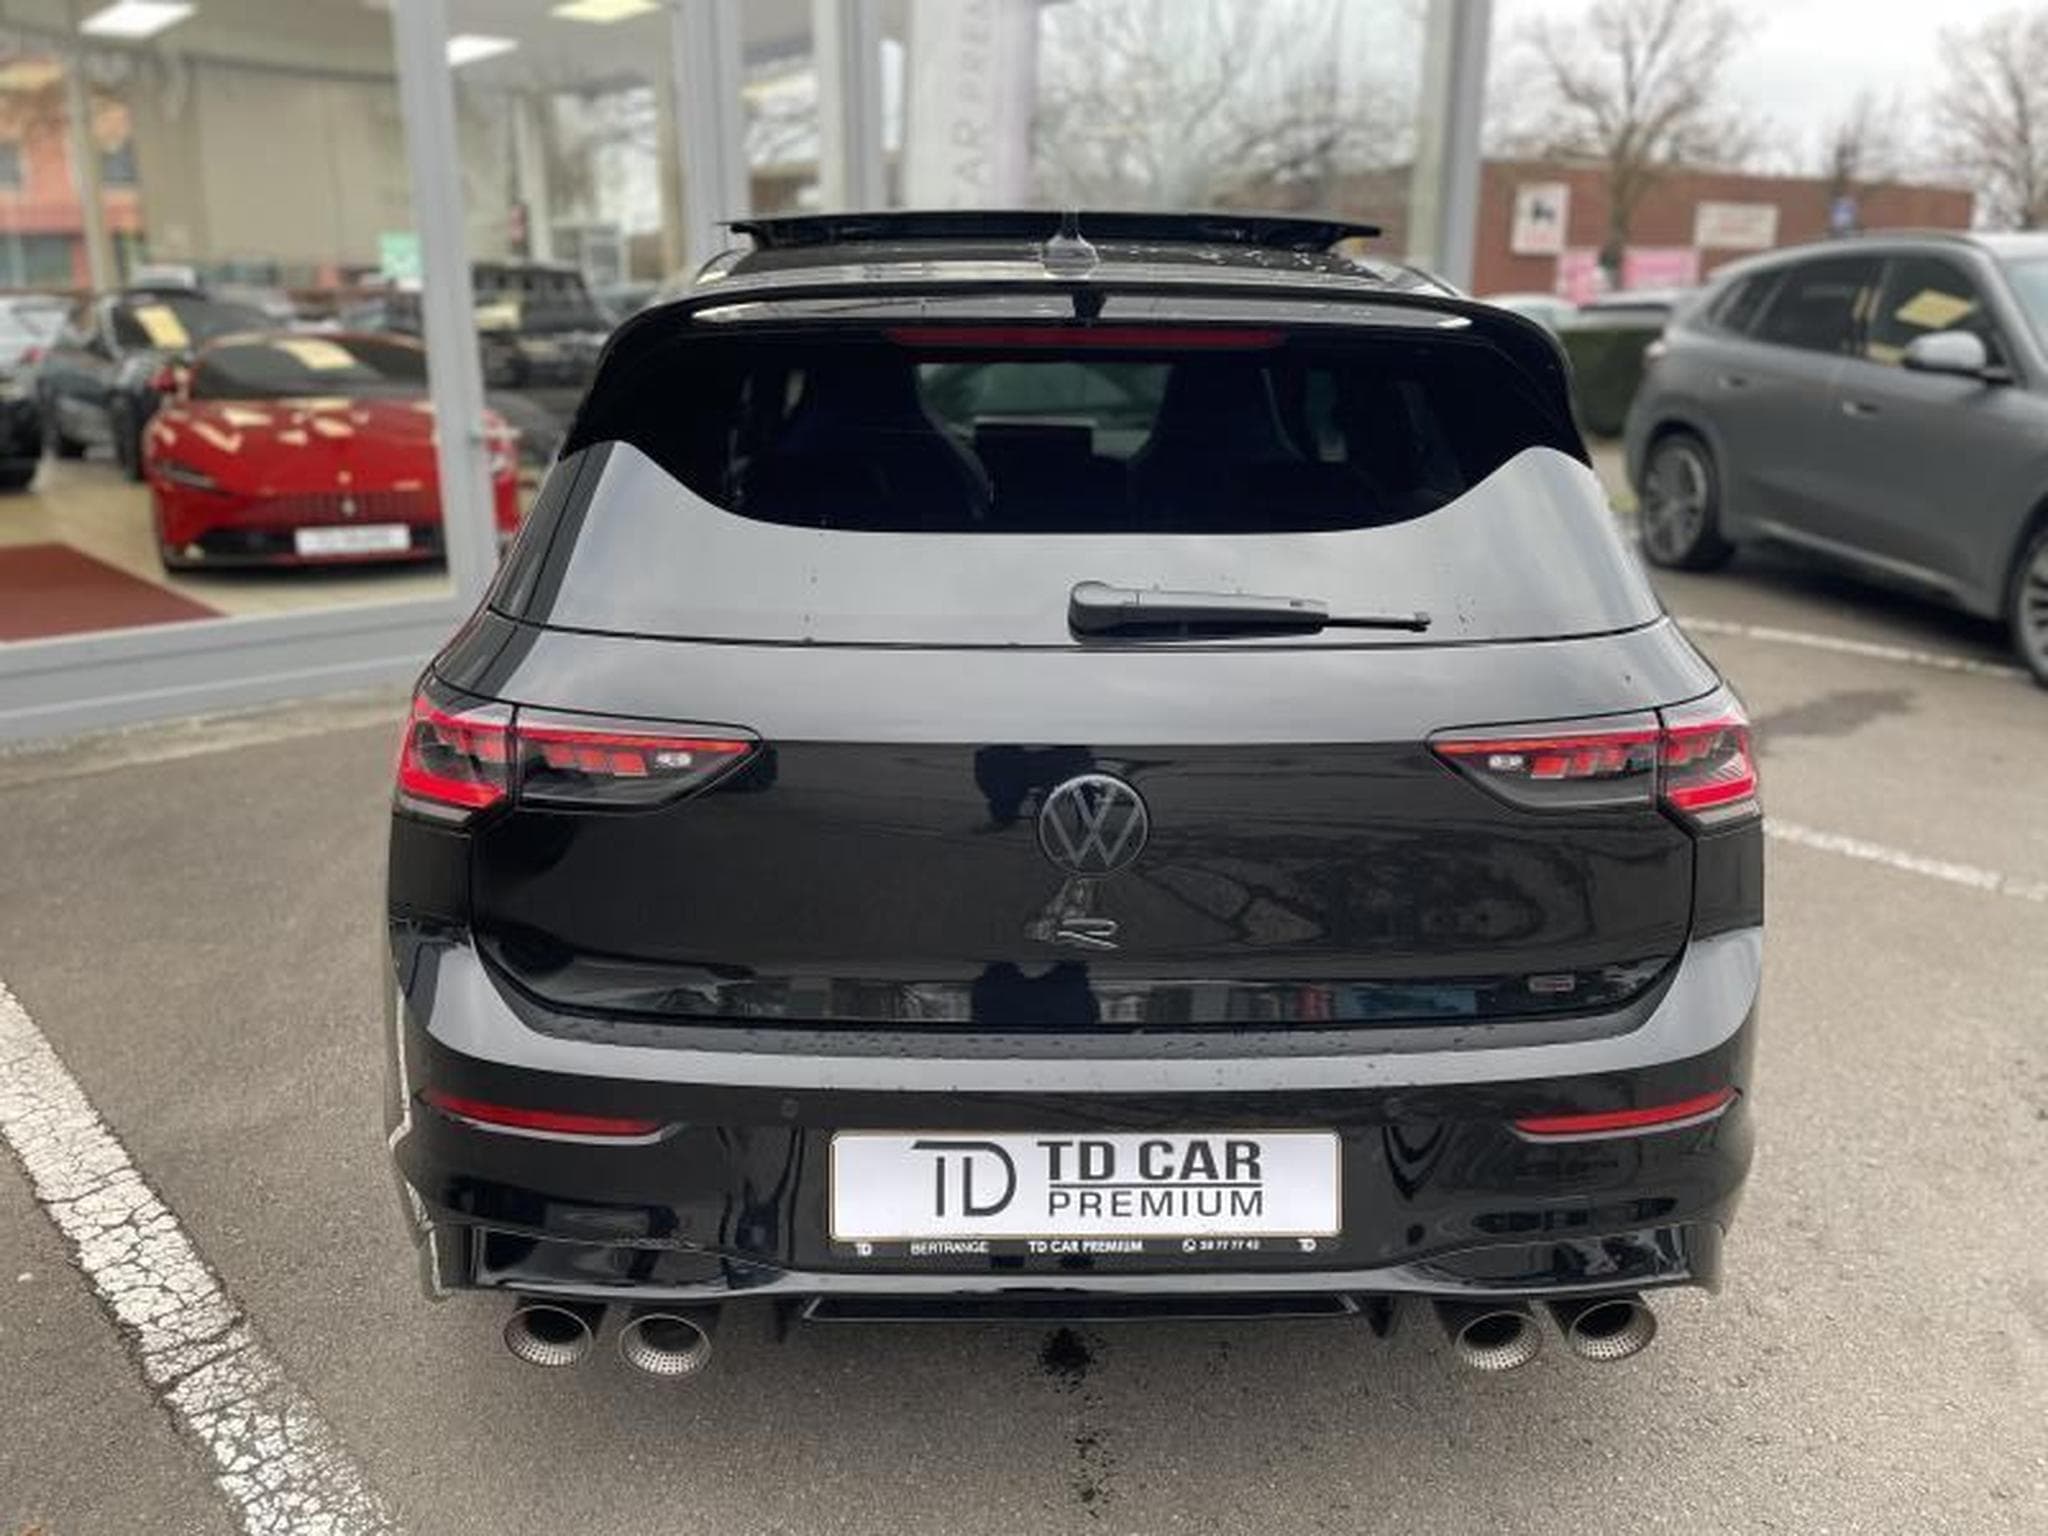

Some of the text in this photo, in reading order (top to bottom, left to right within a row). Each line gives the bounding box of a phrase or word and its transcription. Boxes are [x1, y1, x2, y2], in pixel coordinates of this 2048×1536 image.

[1037, 1140, 1262, 1181] TD CAR
[1049, 1190, 1263, 1217] PREMIUM
[911, 1241, 990, 1255] BERTRANGE
[1028, 1240, 1048, 1253] TD
[1051, 1240, 1079, 1253] CAR
